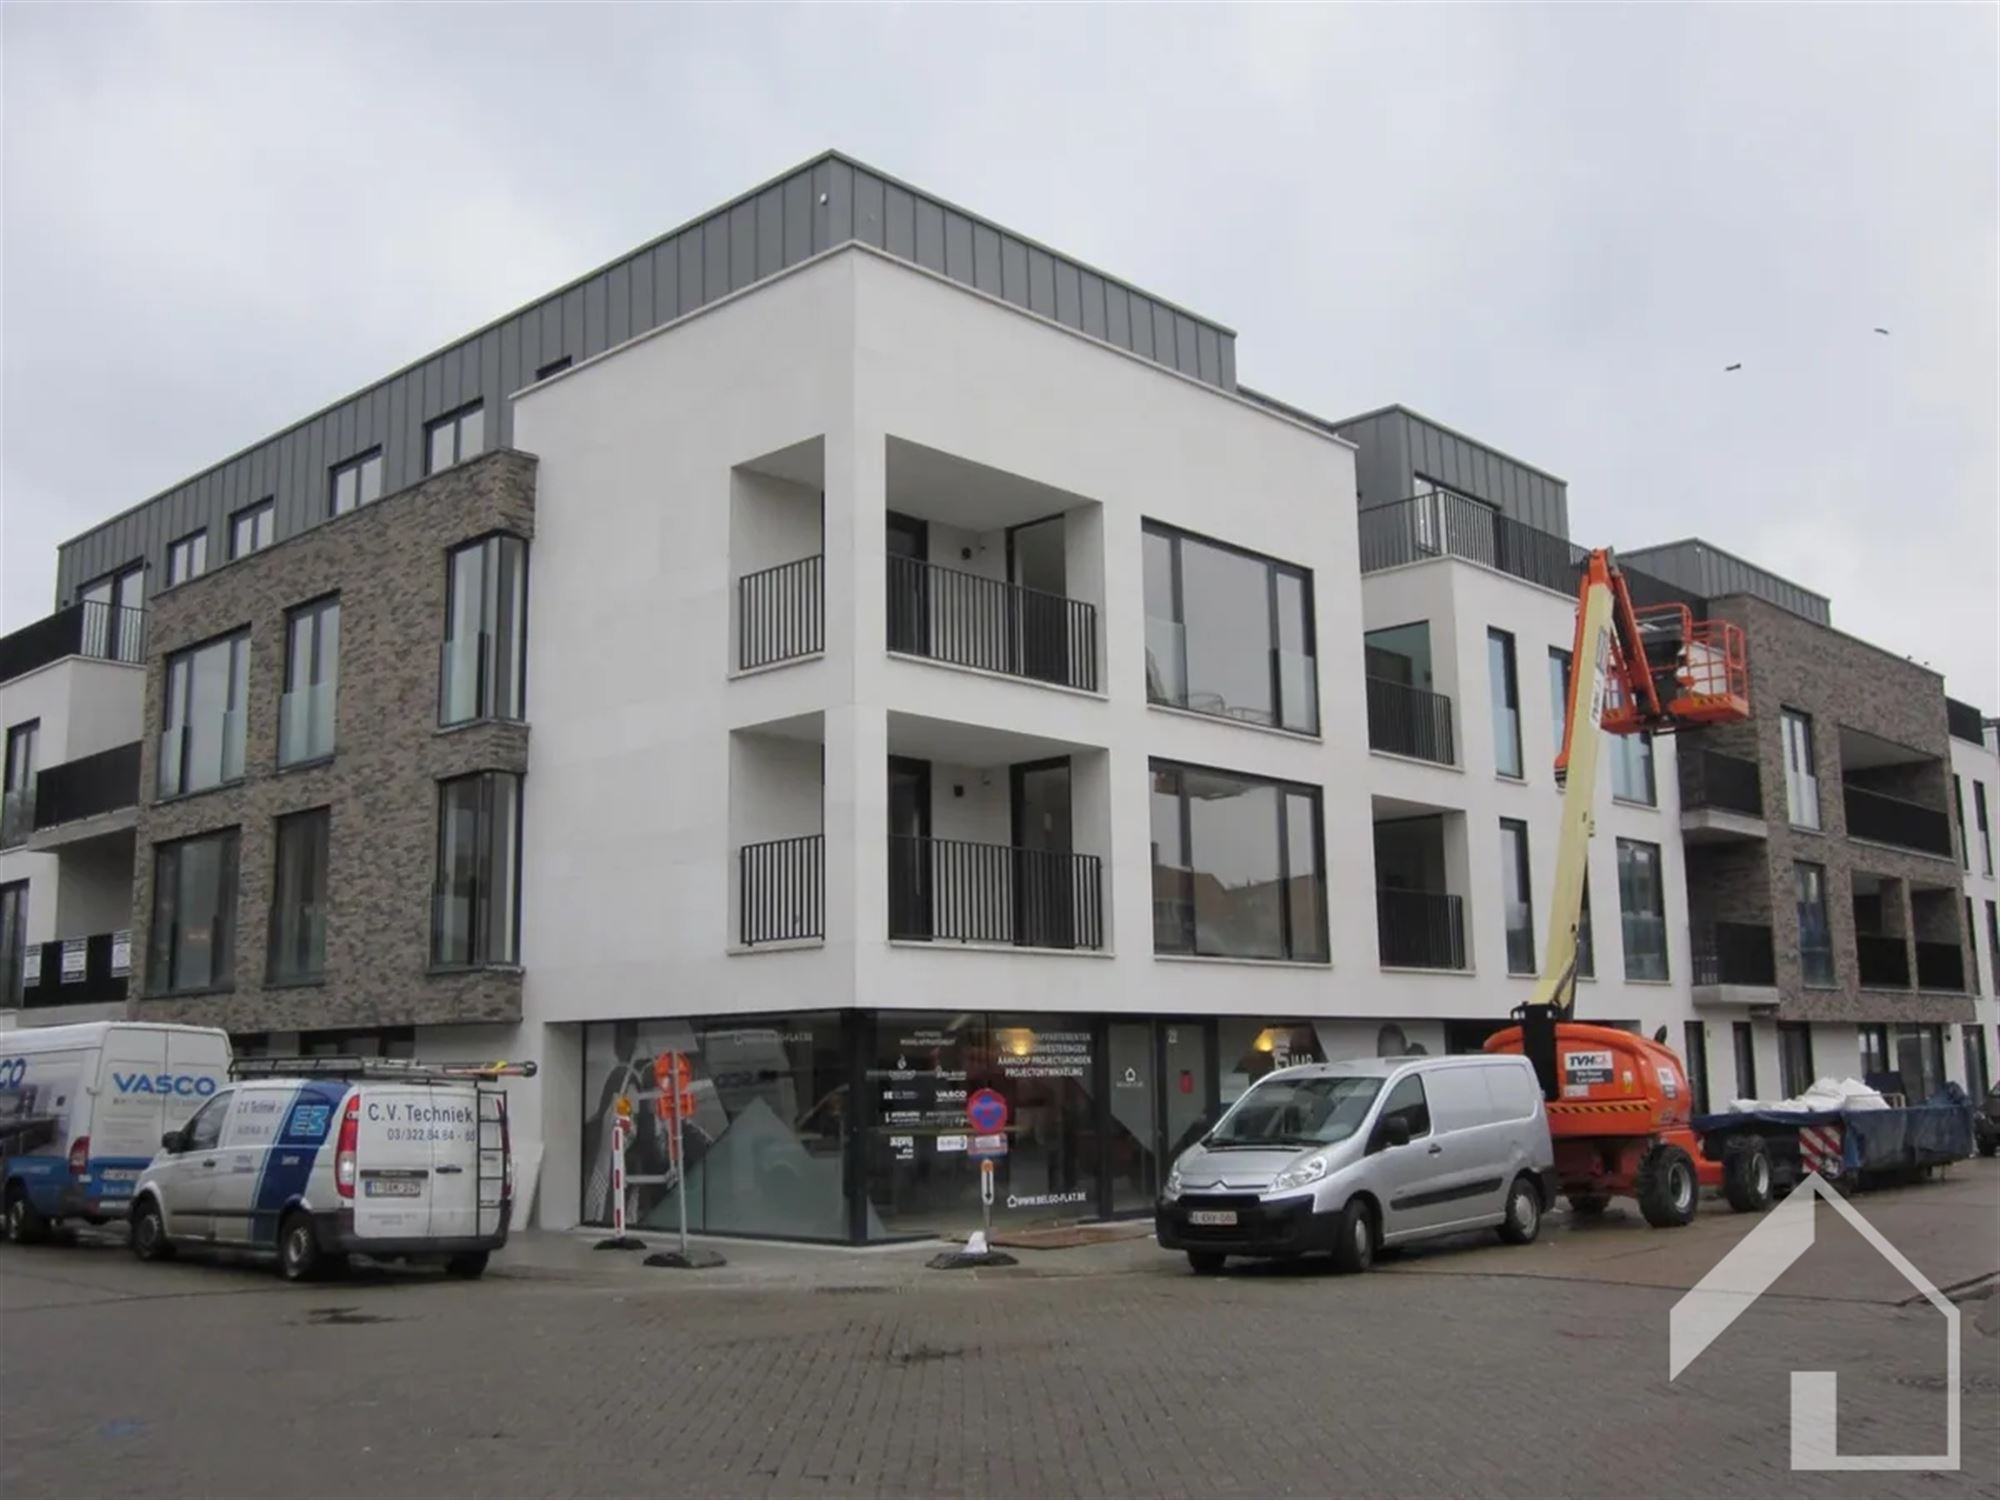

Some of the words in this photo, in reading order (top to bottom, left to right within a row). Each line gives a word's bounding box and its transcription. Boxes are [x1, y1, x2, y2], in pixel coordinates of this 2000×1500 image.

[1570, 1055, 1595, 1067] TVH
[113, 1072, 216, 1095] VASCO
[404, 1104, 474, 1123] Techniek
